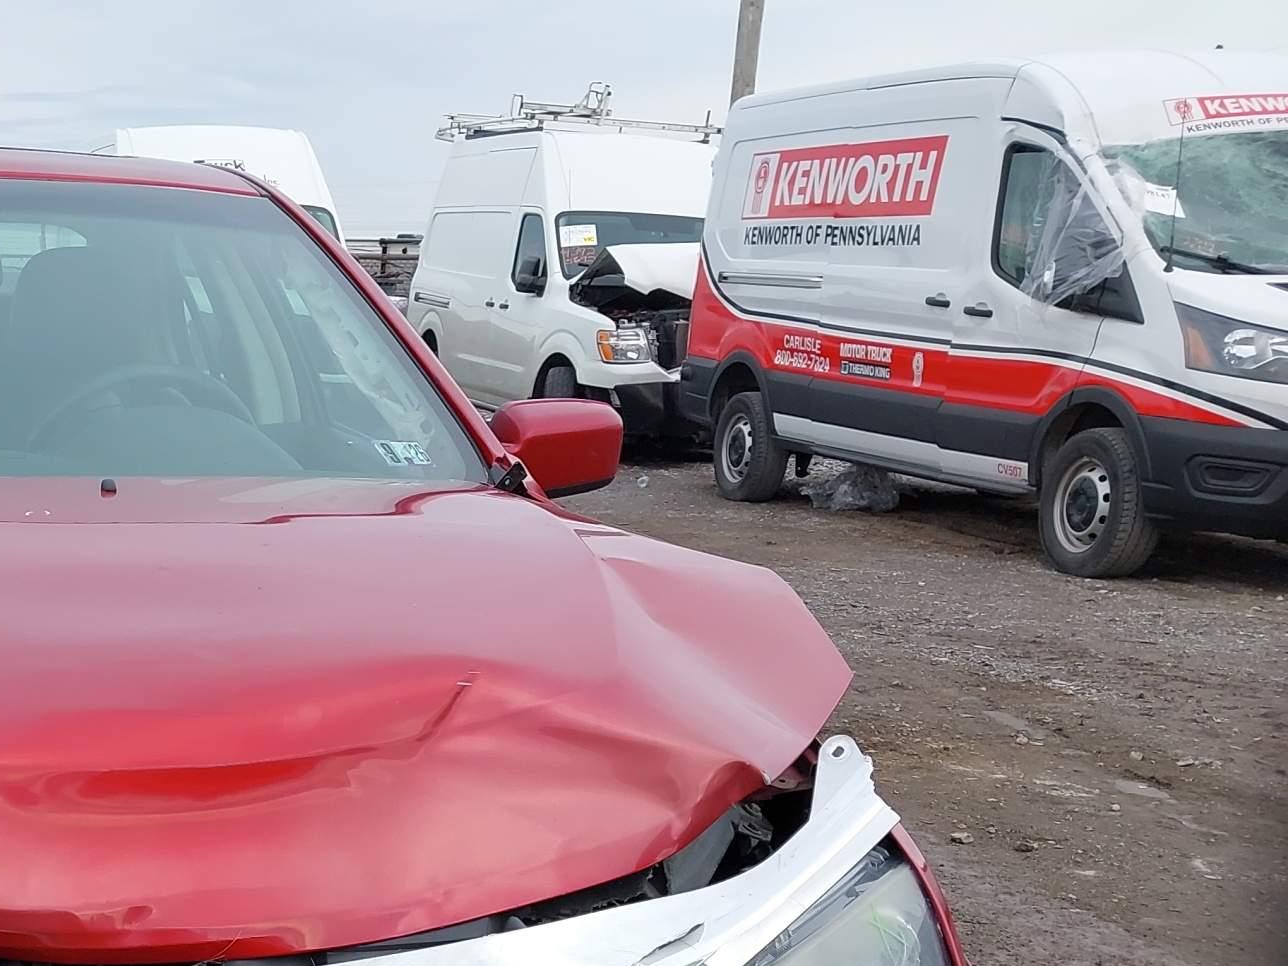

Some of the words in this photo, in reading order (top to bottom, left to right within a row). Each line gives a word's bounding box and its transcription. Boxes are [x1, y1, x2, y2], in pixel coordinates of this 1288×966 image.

[1203, 97, 1288, 115] KENW
[1187, 118, 1252, 133] KENWORTH
[1257, 117, 1272, 126] OF
[774, 150, 939, 208] KENWORTH
[744, 225, 802, 246] KENWORTH
[805, 224, 823, 245] OF
[824, 224, 921, 247] PENNSYLVANIA
[784, 335, 821, 354] CARLISLE
[840, 343, 865, 358] MOTOR
[867, 346, 893, 362] TRUCK
[849, 362, 875, 377] THERMO
[875, 366, 891, 379] KING
